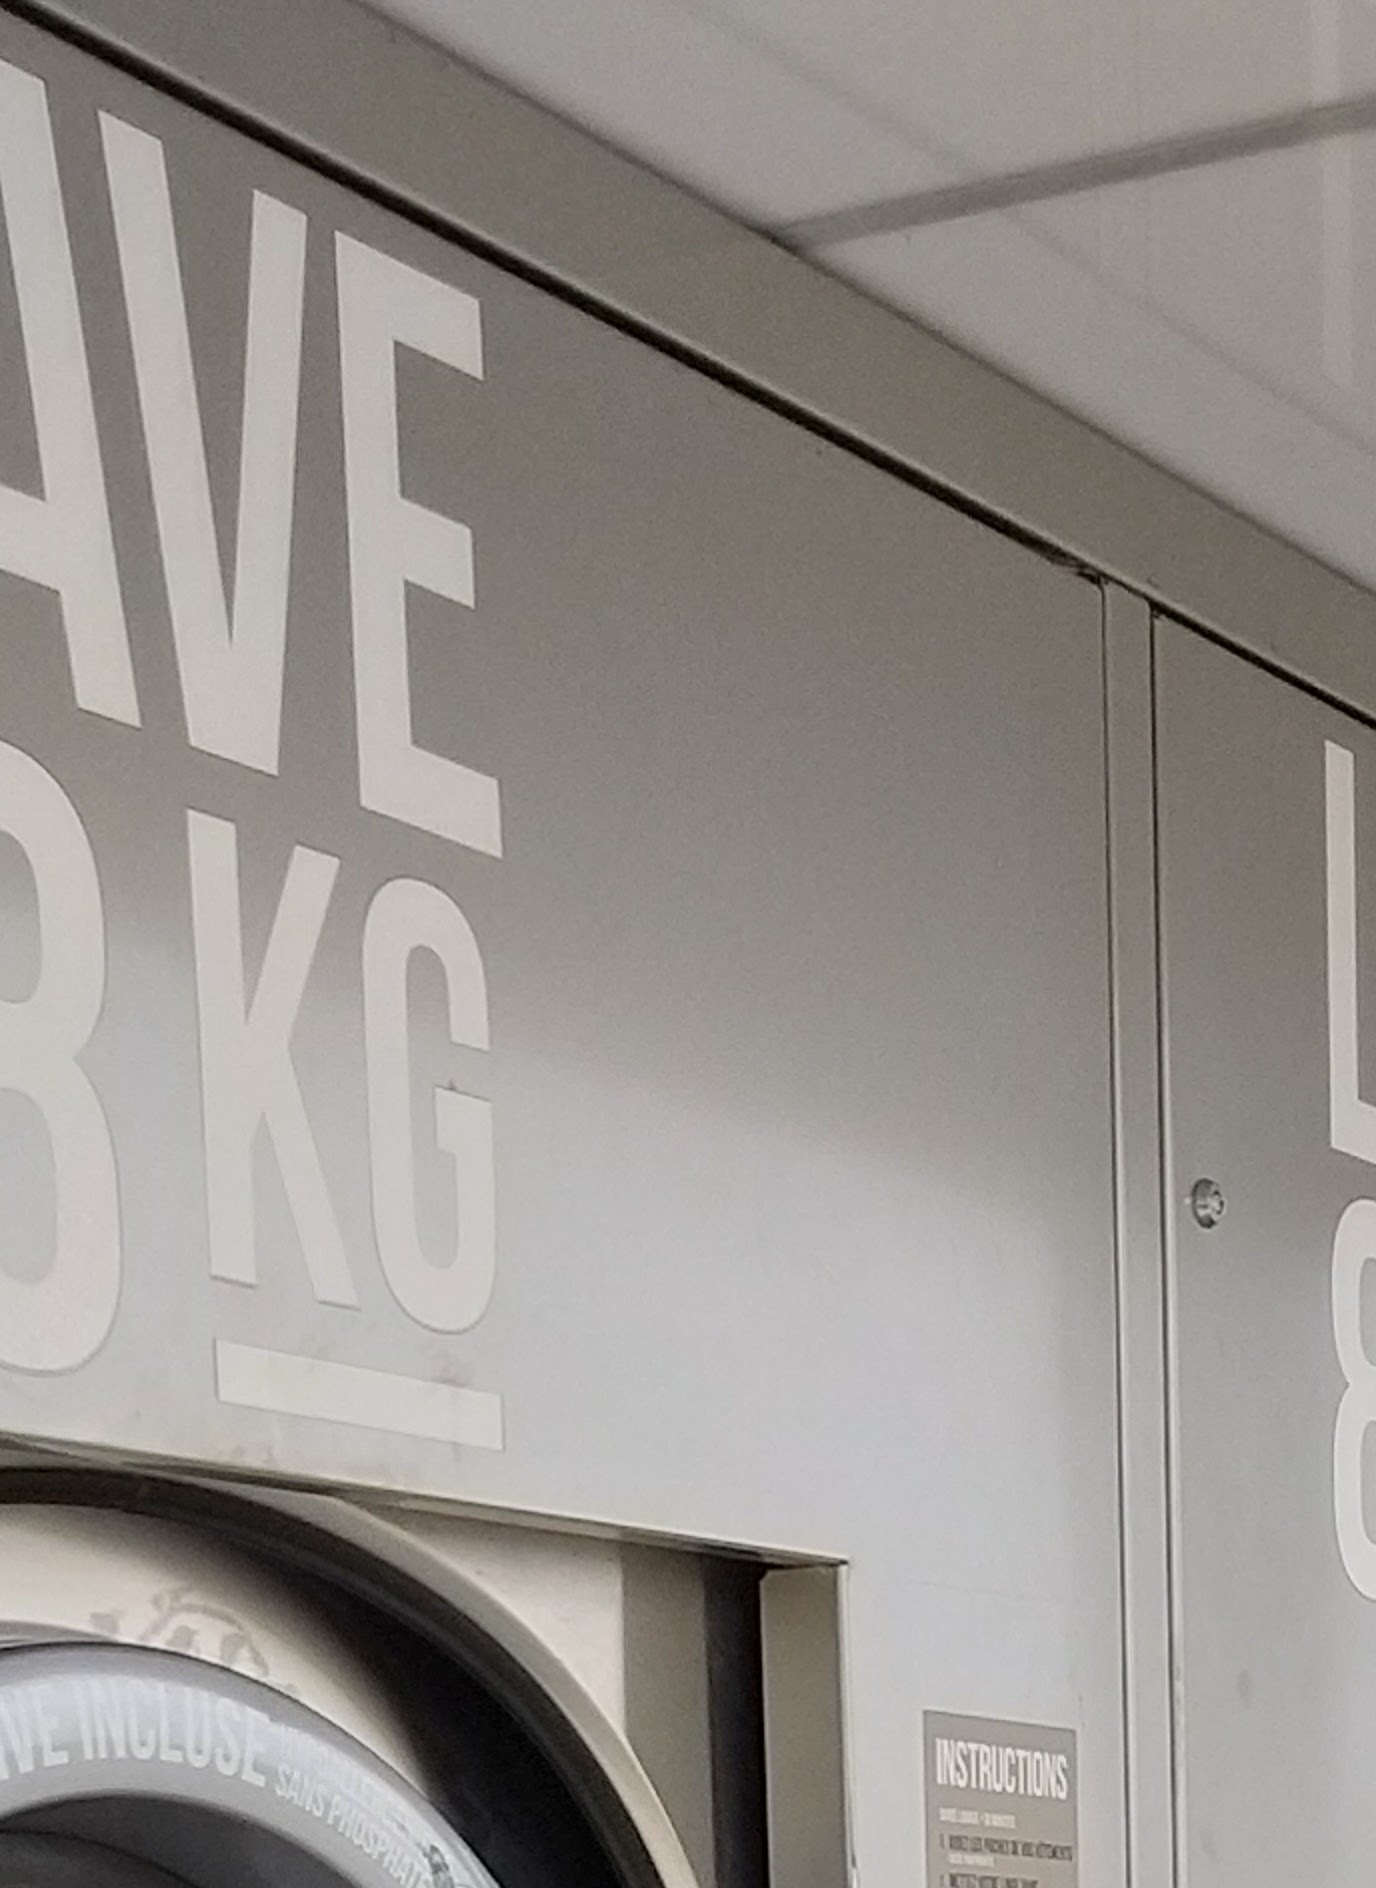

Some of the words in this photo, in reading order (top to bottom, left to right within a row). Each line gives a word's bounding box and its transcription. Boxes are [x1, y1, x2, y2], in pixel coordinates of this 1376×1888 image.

[187, 807, 497, 1335] KG
[72, 1675, 267, 1788] INCLUSE
[935, 1737, 1068, 1800] INSTRUCTIONS
